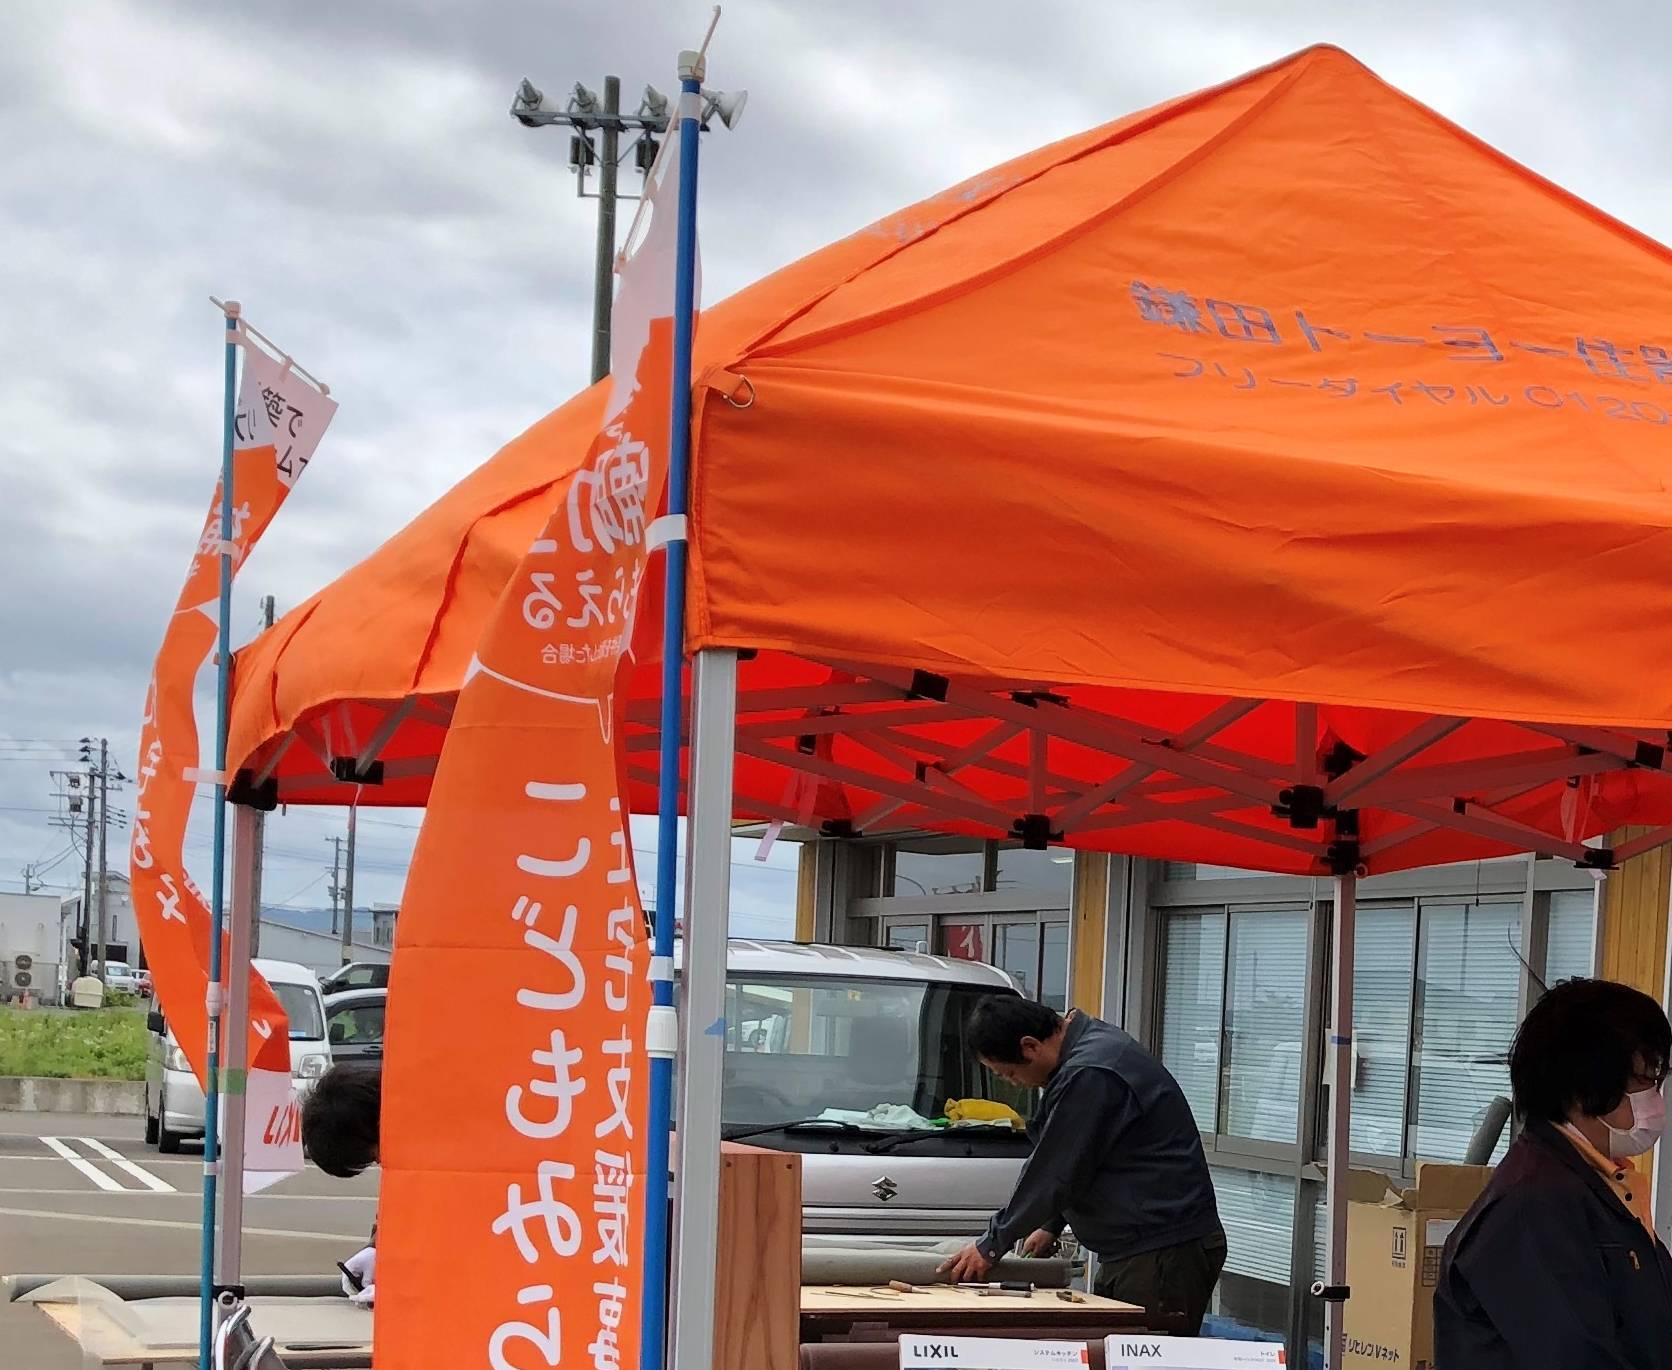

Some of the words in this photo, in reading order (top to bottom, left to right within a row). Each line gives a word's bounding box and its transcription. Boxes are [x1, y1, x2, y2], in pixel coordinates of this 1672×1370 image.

[1156, 352, 1510, 405] フリーダイヤル
[913, 1344, 959, 1358] LIXIL
[1121, 1344, 1162, 1357] INAX
